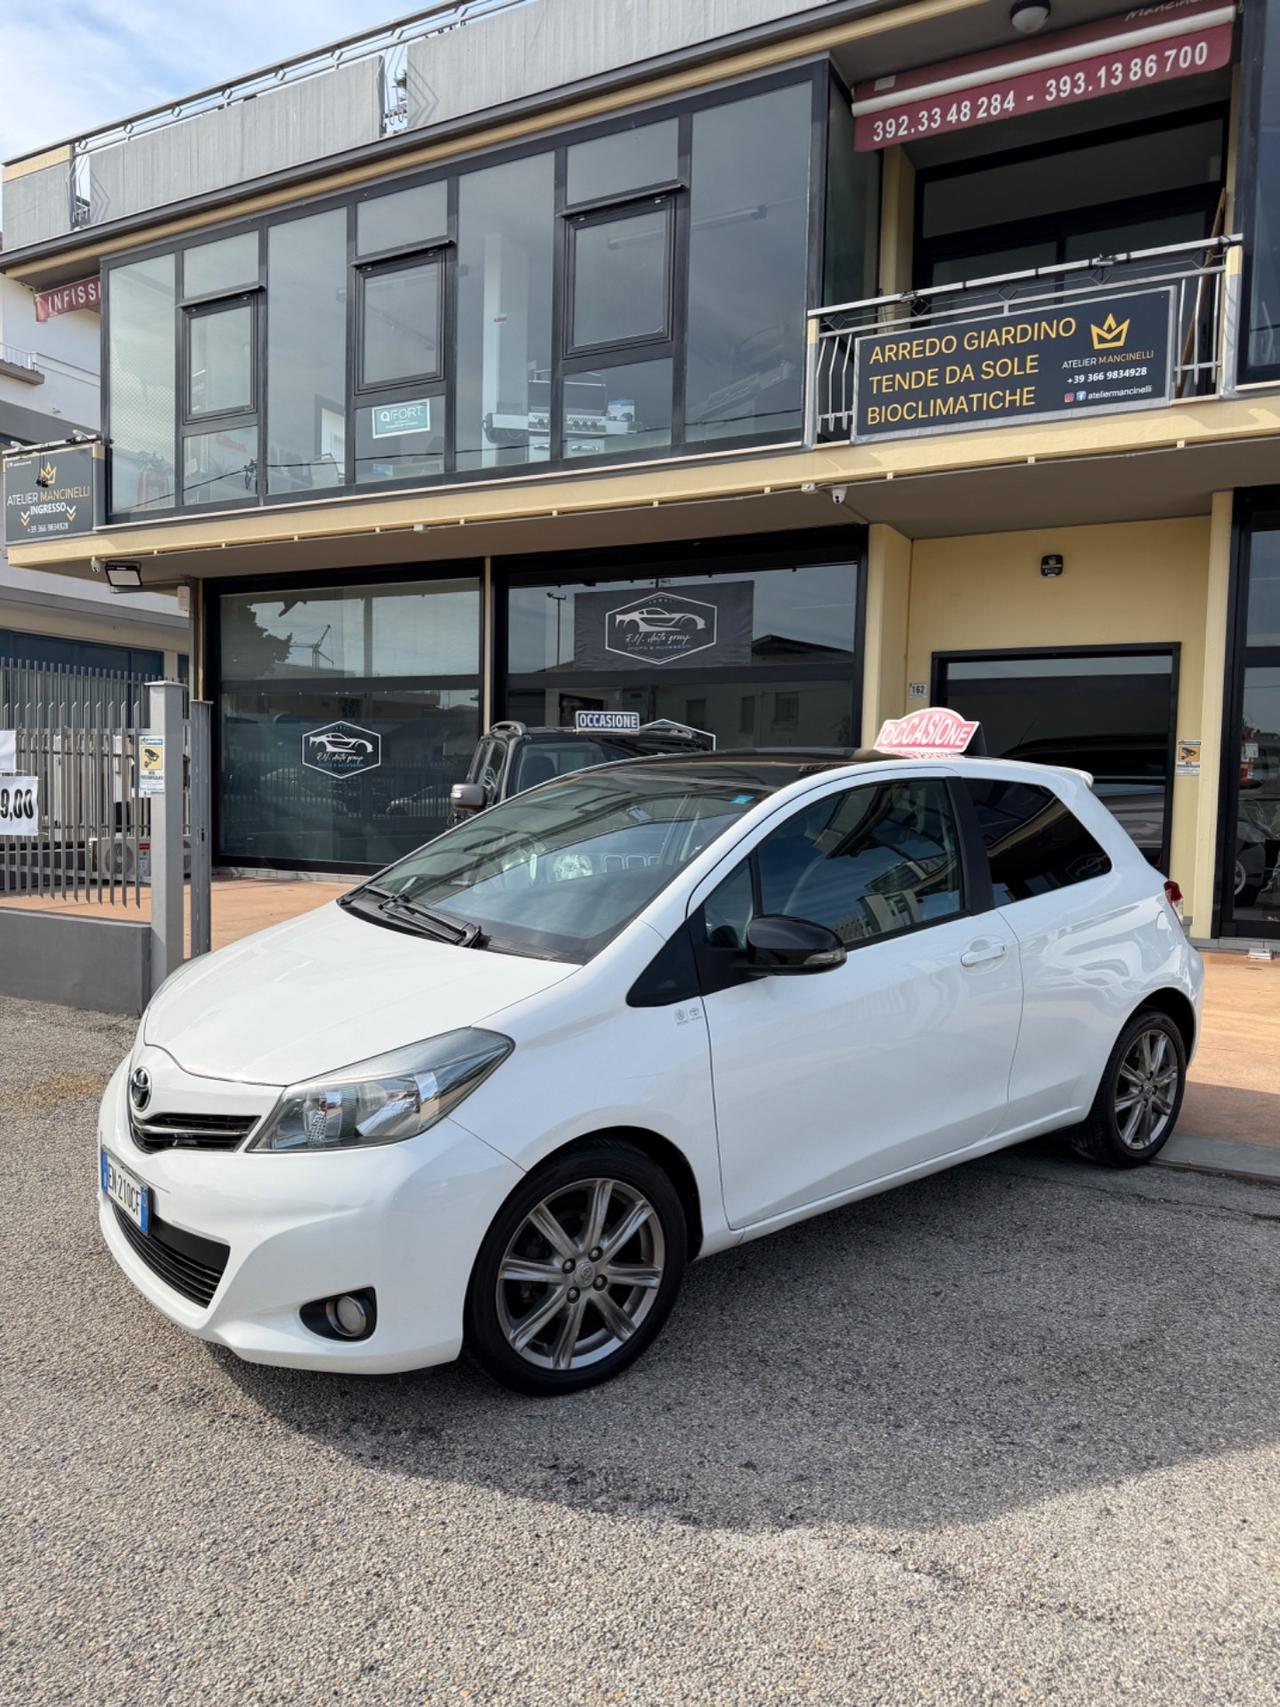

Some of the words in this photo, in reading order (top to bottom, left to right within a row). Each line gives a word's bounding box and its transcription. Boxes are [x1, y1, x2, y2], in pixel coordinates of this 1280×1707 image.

[869, 334, 957, 365] ARREDO
[963, 317, 1076, 351] GIARDINO
[1062, 357, 1097, 369] ATELIER
[1098, 350, 1154, 364] MANCINELLI
[870, 367, 939, 394] TENDE
[945, 361, 976, 385] DA
[981, 354, 1039, 380] SOLE
[1067, 375, 1085, 384] +39
[1087, 372, 1104, 383] 366
[1106, 366, 1148, 380] 9834928
[1088, 385, 1153, 399] ateliermancinelli
[380, 406, 423, 422] QFORT
[867, 386, 1036, 426] BIOCLIMATICHE
[7, 492, 39, 507] ATELIER
[40, 485, 90, 502] MANCINELLI
[30, 502, 67, 515] INGRESSO
[912, 685, 925, 694] 162
[579, 713, 637, 728] OCCASIONE
[881, 714, 972, 746] OCCASIONE
